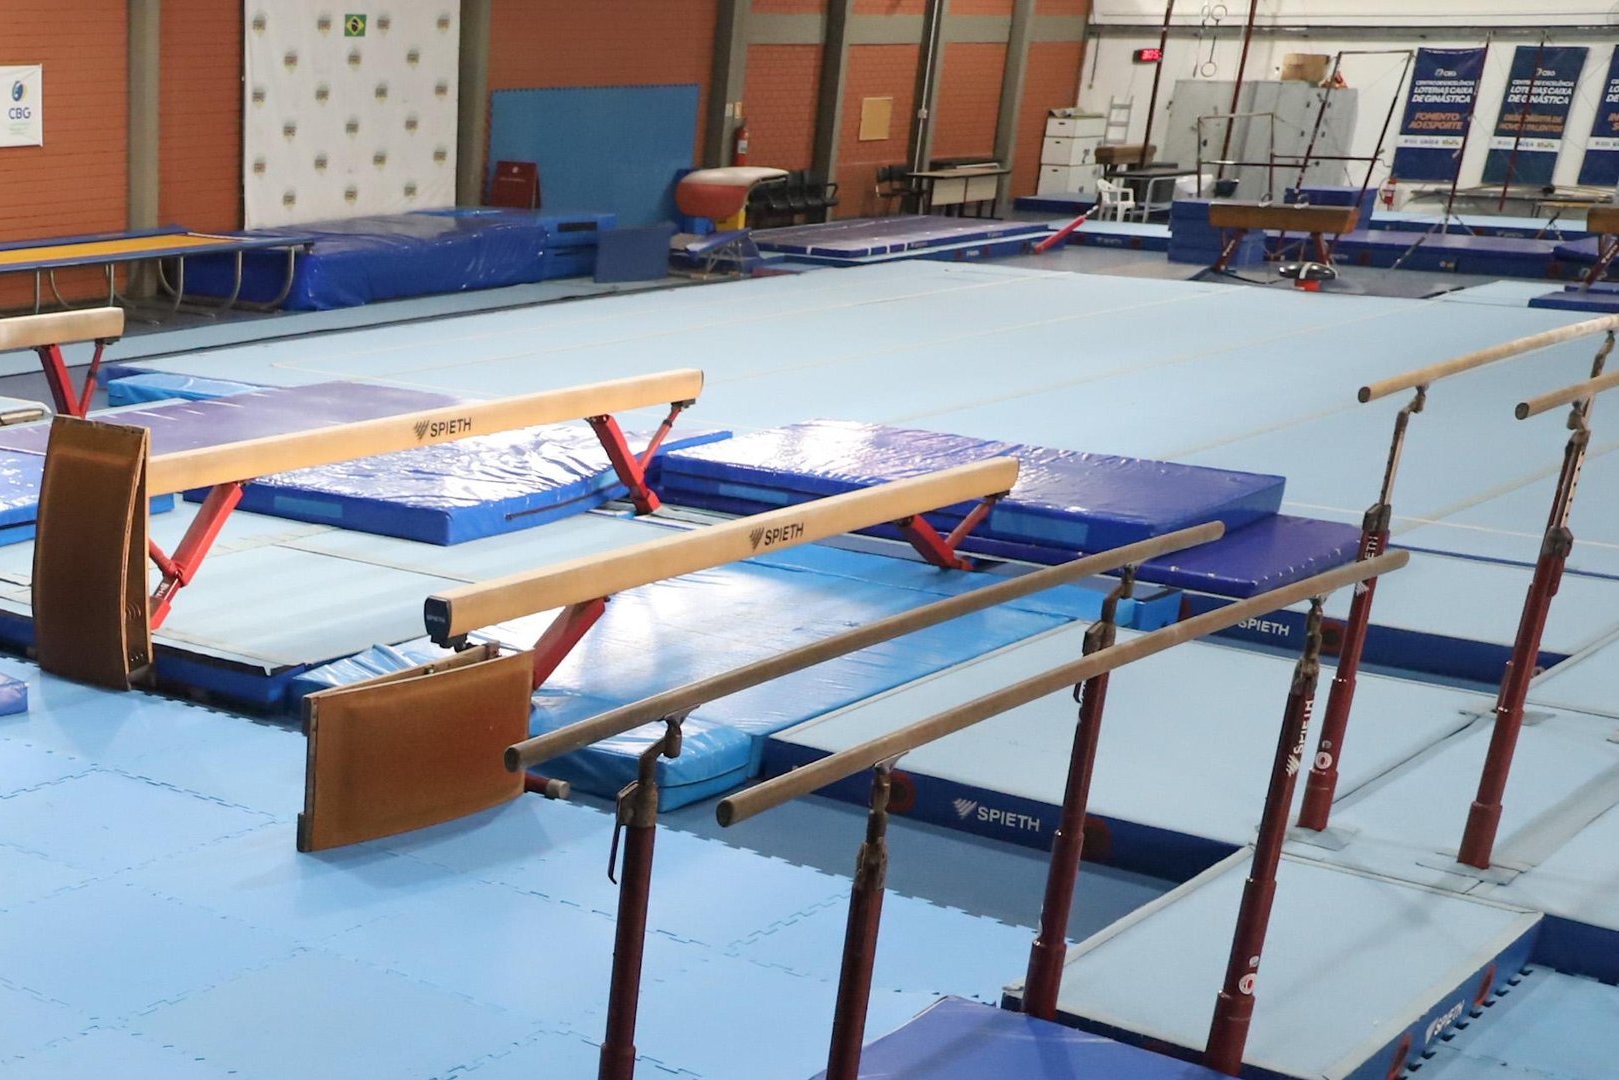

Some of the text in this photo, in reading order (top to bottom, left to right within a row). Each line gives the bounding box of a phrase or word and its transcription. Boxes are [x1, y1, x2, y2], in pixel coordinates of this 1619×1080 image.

[1521, 94, 1569, 104] GNÁSTICA
[8, 107, 31, 120] CBG
[430, 417, 472, 437] SPIETH
[764, 522, 804, 546] SPIETH
[1237, 618, 1290, 637] SPIETH
[977, 806, 1040, 832] SPIETH
[1433, 999, 1465, 1035] SPIETH
